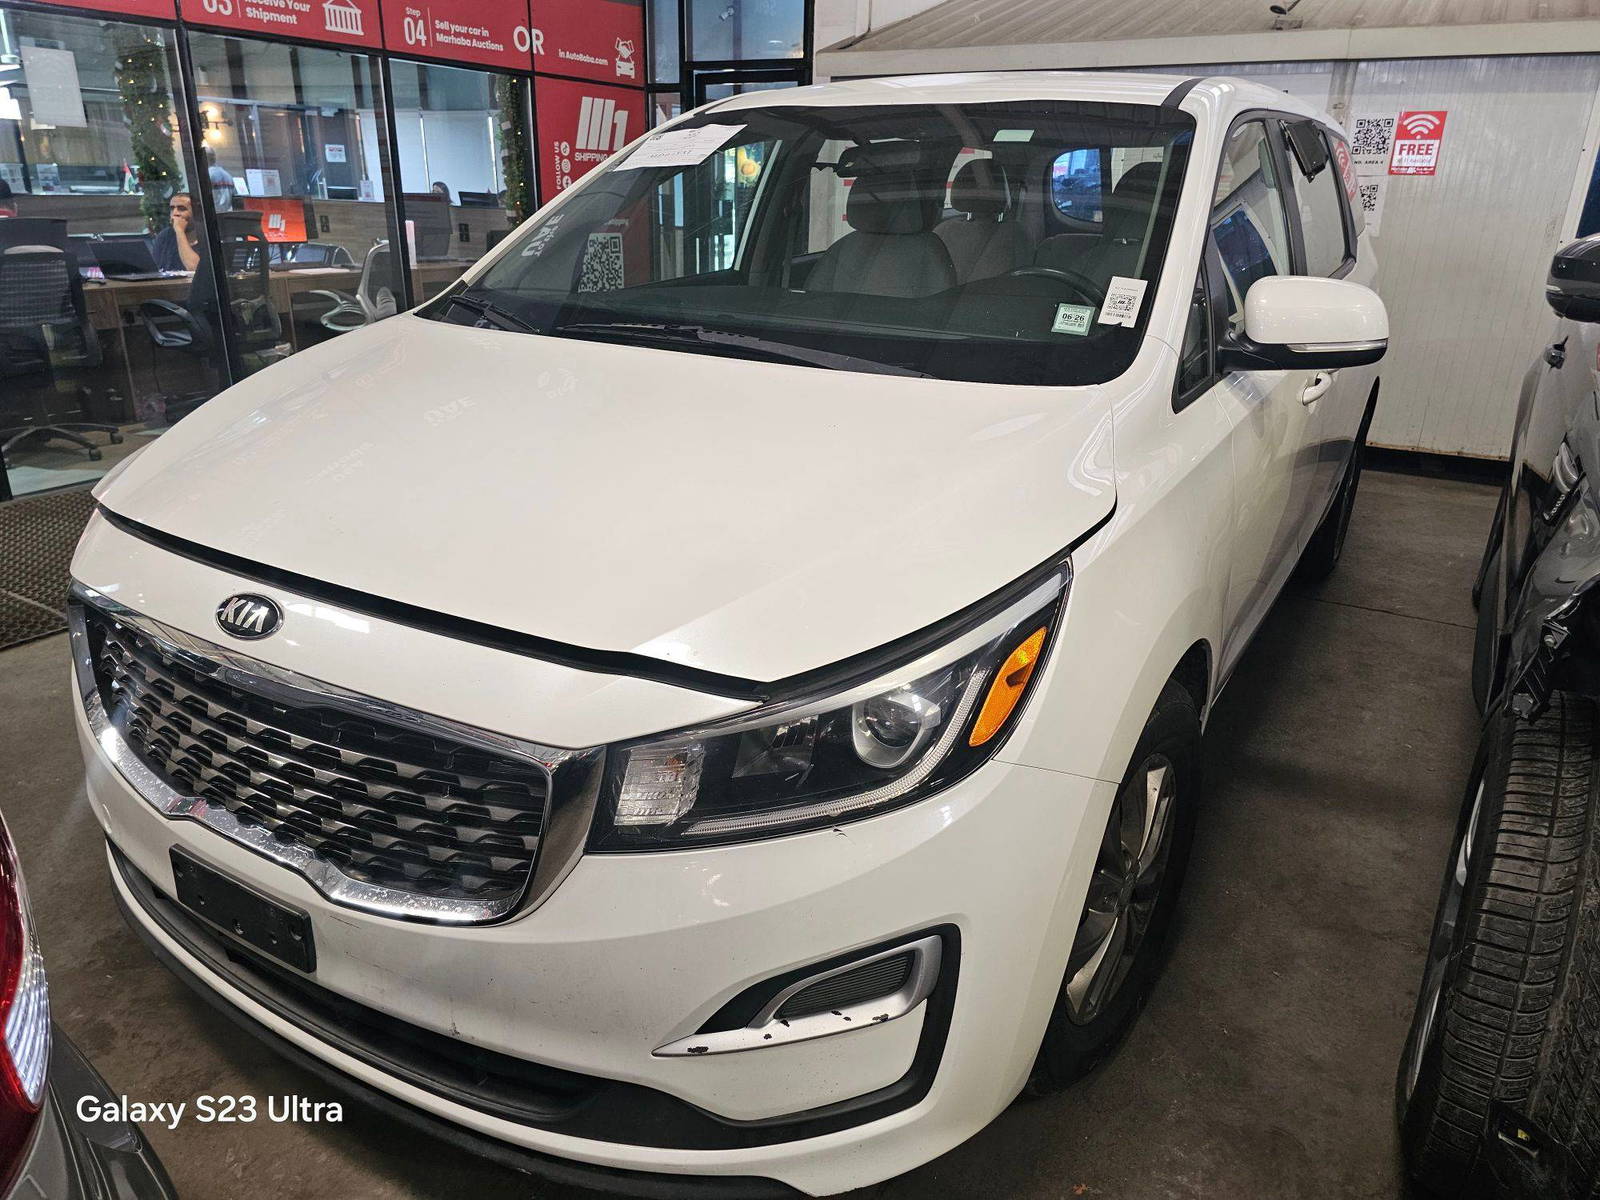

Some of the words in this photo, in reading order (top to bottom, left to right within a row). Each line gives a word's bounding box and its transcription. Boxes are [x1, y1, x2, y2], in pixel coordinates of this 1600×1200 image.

[243, 0, 286, 9] eceive
[288, 0, 311, 12] Your
[405, 6, 421, 17] Step
[246, 7, 298, 25] Shipment
[404, 17, 427, 47] 04
[435, 19, 451, 31] Sell
[450, 22, 468, 33] your
[469, 28, 482, 36] car
[482, 27, 490, 37] in
[436, 33, 472, 46] Marhaba
[472, 39, 504, 52] Auctions
[513, 25, 545, 55] OR
[558, 48, 565, 59] in
[553, 141, 560, 153] US
[1398, 143, 1434, 156] FREE
[574, 152, 608, 162] SHIPPING
[554, 155, 562, 190] FOLLOW
[220, 597, 269, 633] KIA
